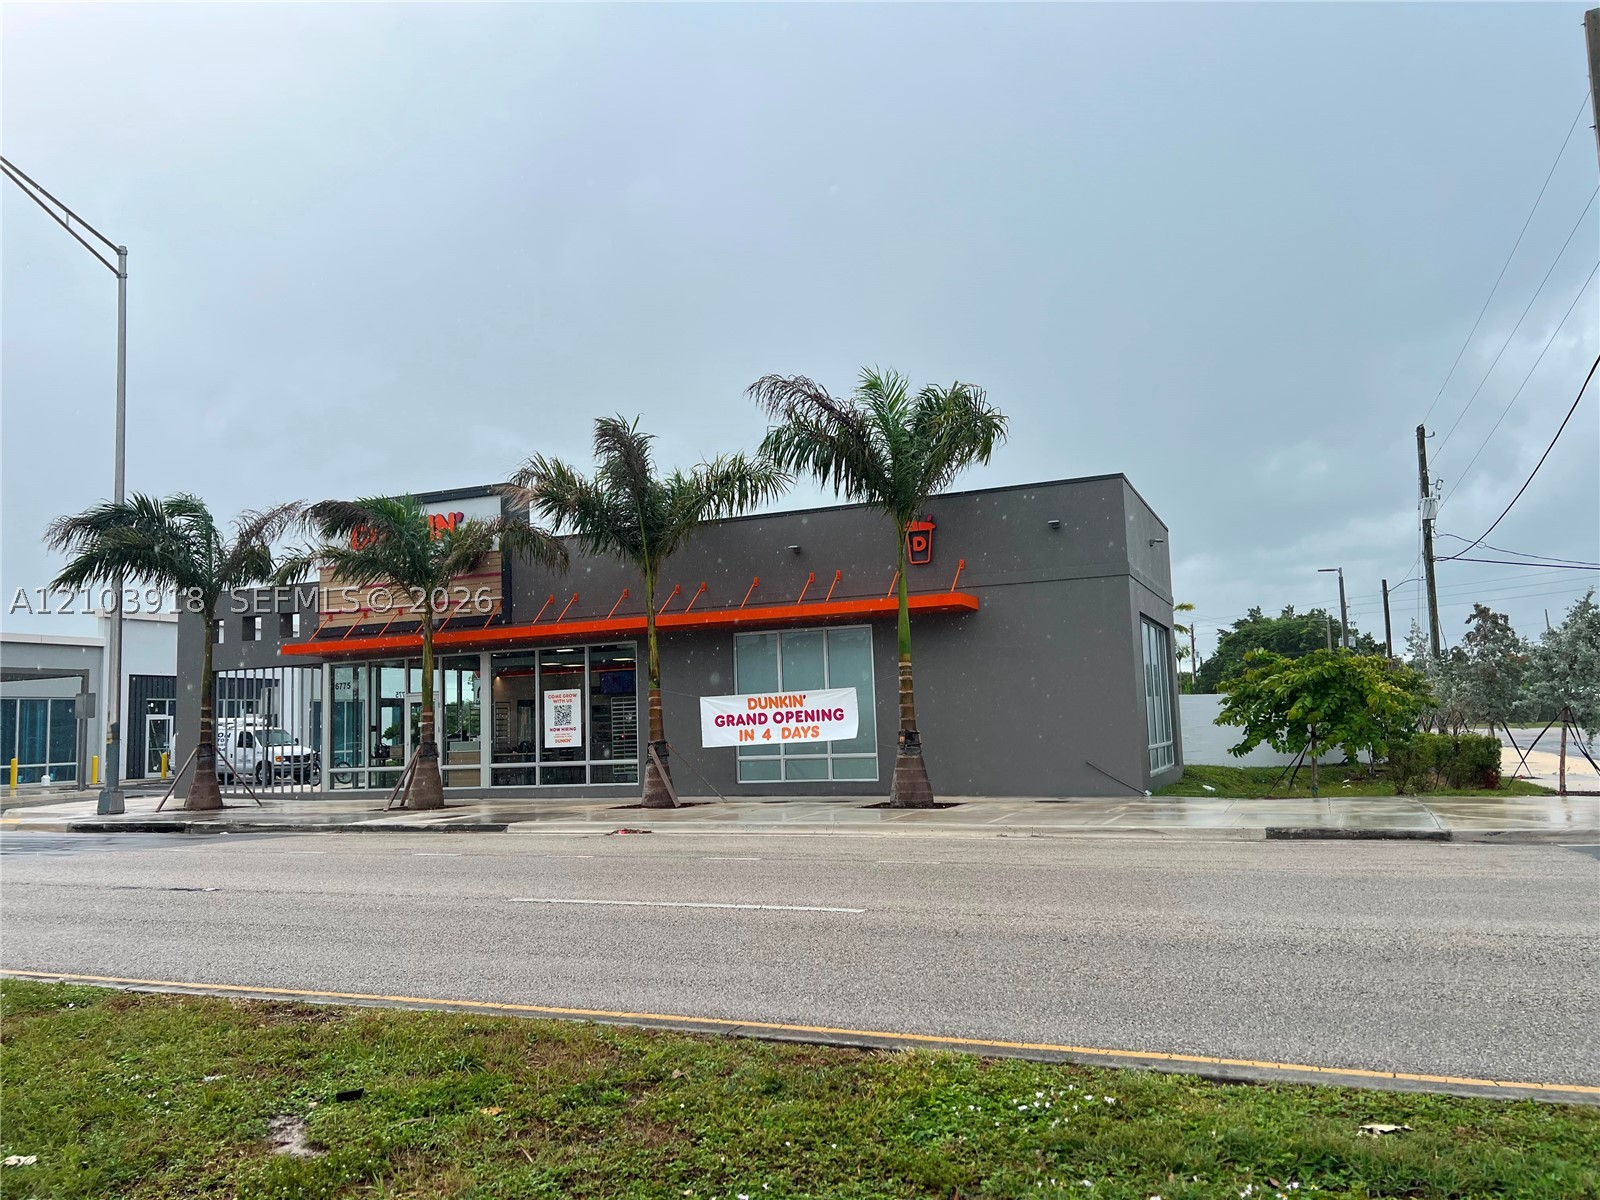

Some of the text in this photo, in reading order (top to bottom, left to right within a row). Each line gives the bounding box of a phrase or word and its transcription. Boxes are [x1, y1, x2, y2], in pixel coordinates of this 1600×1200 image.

[912, 535, 927, 552] D
[747, 694, 806, 711] DUNKIN'
[714, 707, 845, 728] GRAND OPENING
[738, 725, 820, 742] IN 4 DAYS
